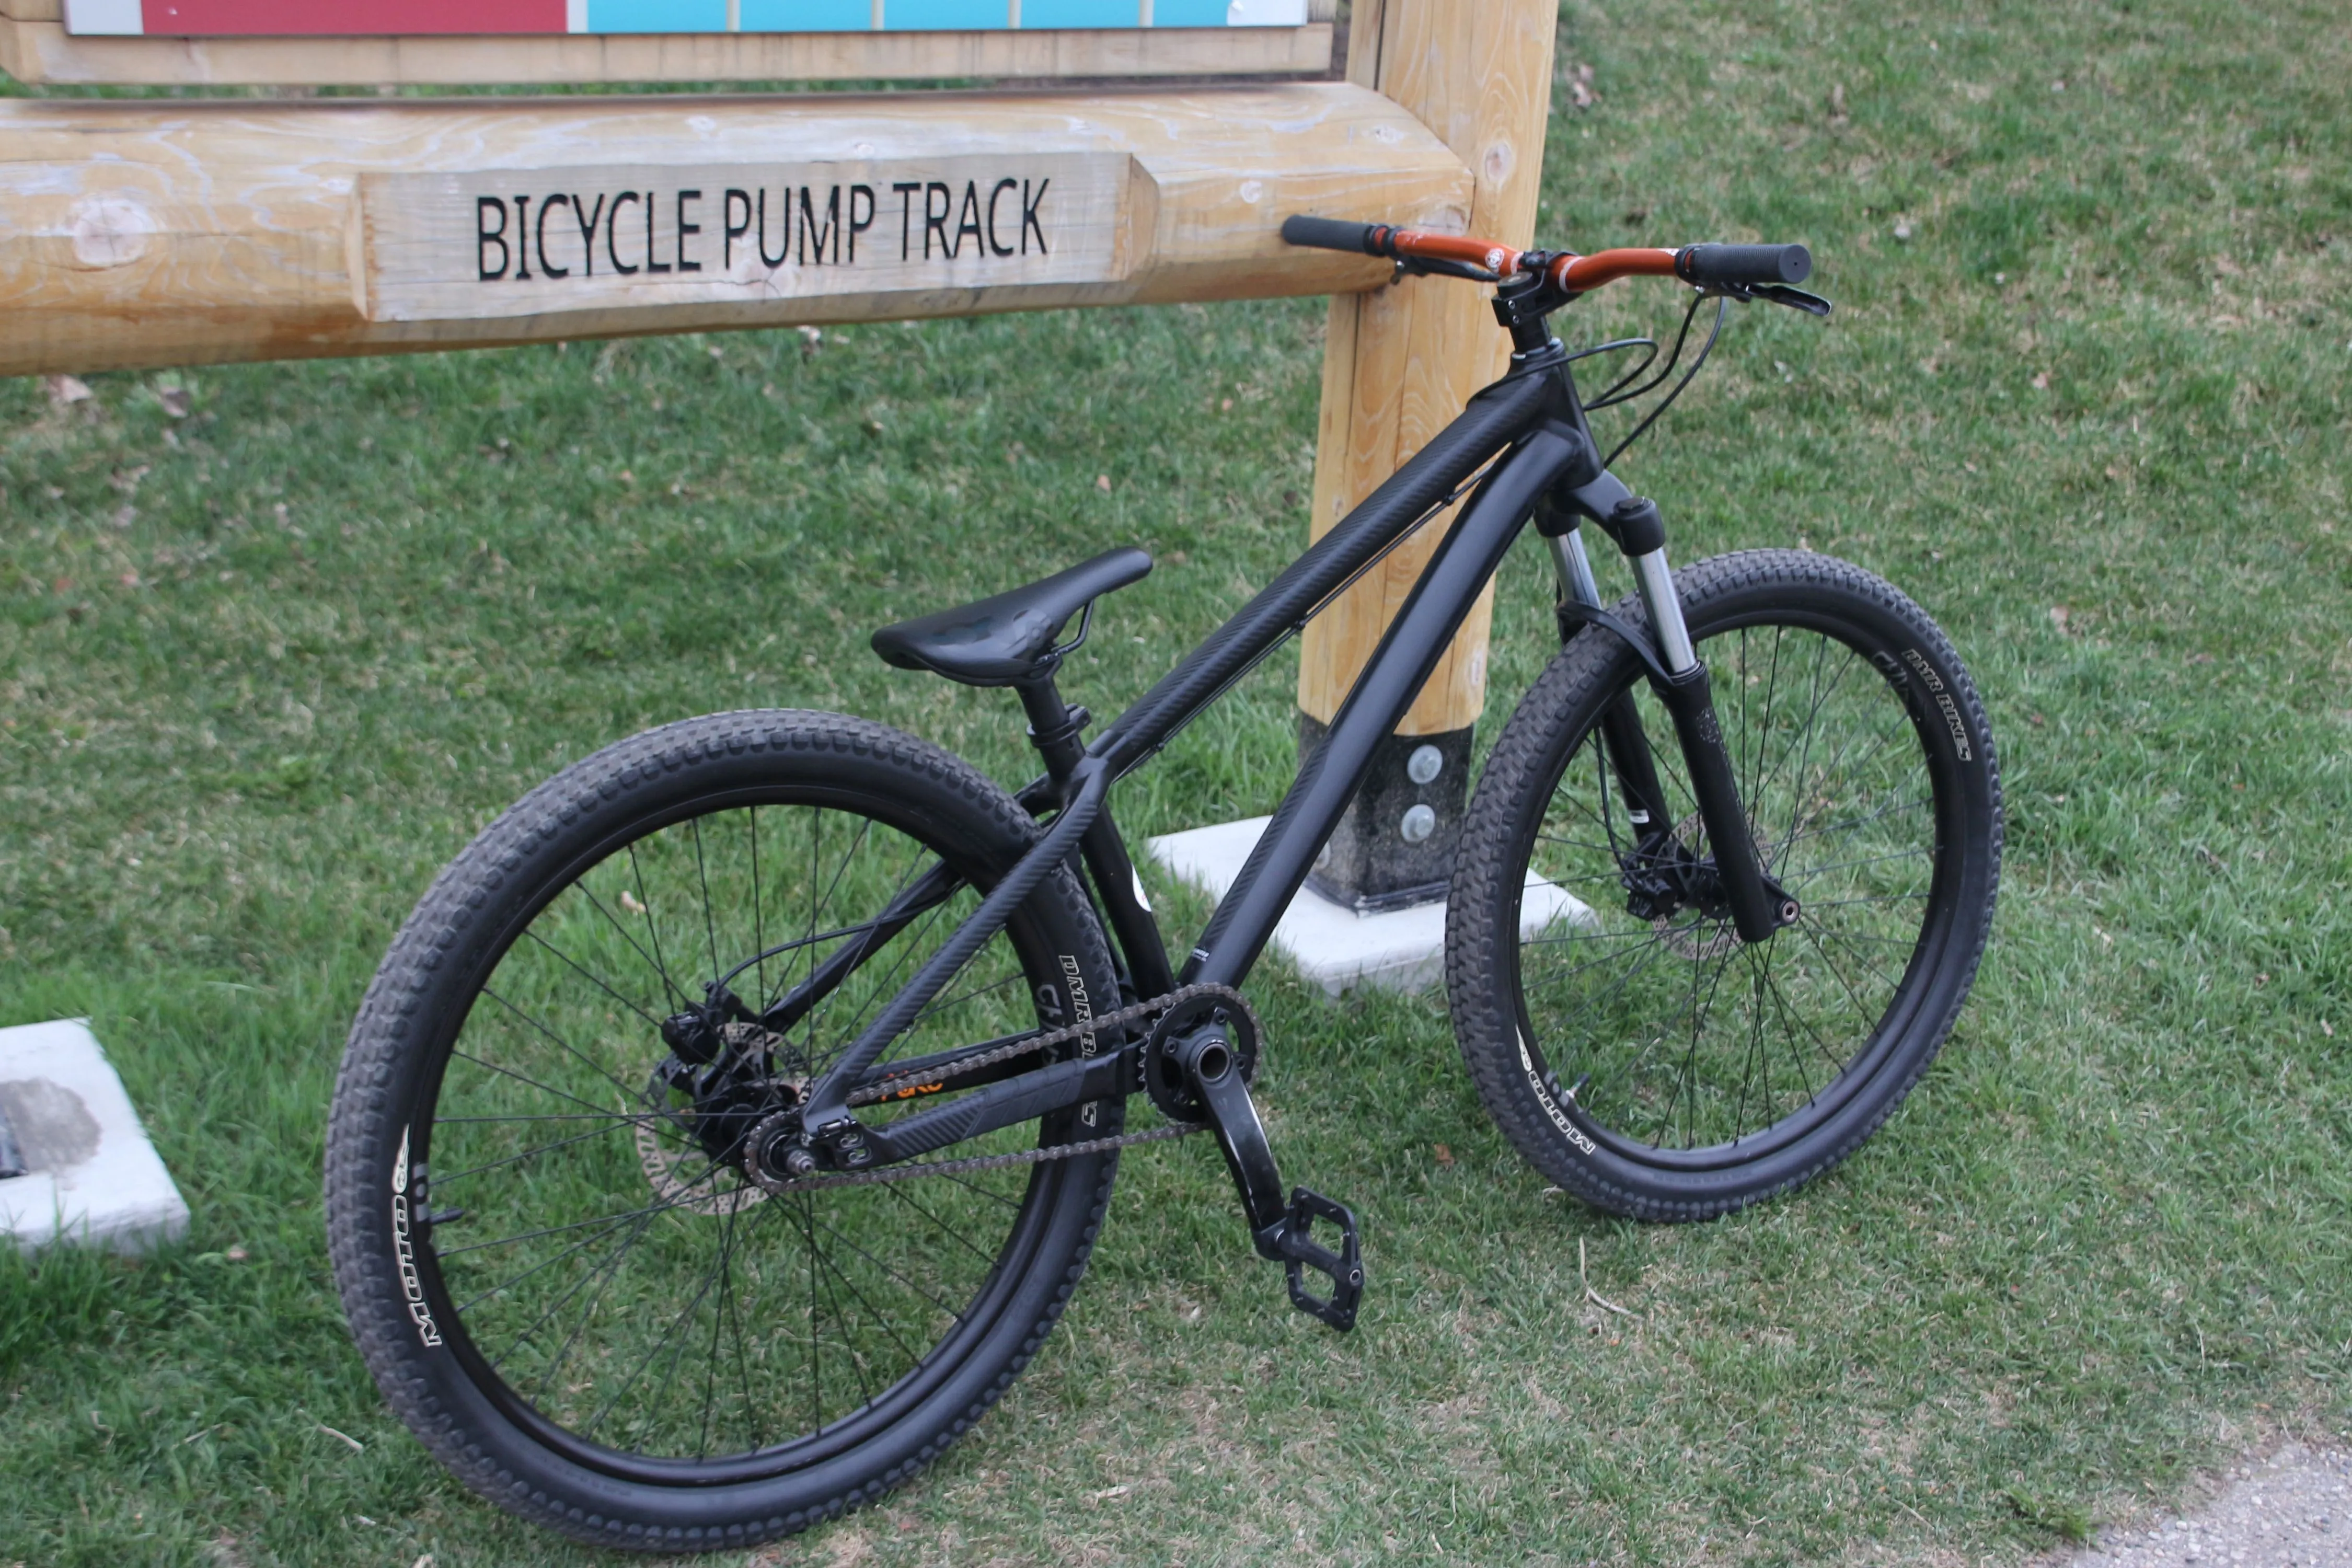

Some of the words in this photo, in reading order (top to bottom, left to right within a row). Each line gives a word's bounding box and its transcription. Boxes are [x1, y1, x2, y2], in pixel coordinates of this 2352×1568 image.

[477, 190, 702, 282] BICYCLE
[725, 184, 876, 270] PUMP
[893, 178, 1050, 261] TRACK
[1901, 648, 1944, 693] DMR
[1935, 693, 1972, 762] BIKES
[1058, 954, 1094, 1027] DMR
[1527, 1070, 1596, 1156] MOTO
[391, 1194, 443, 1347] MOTO
